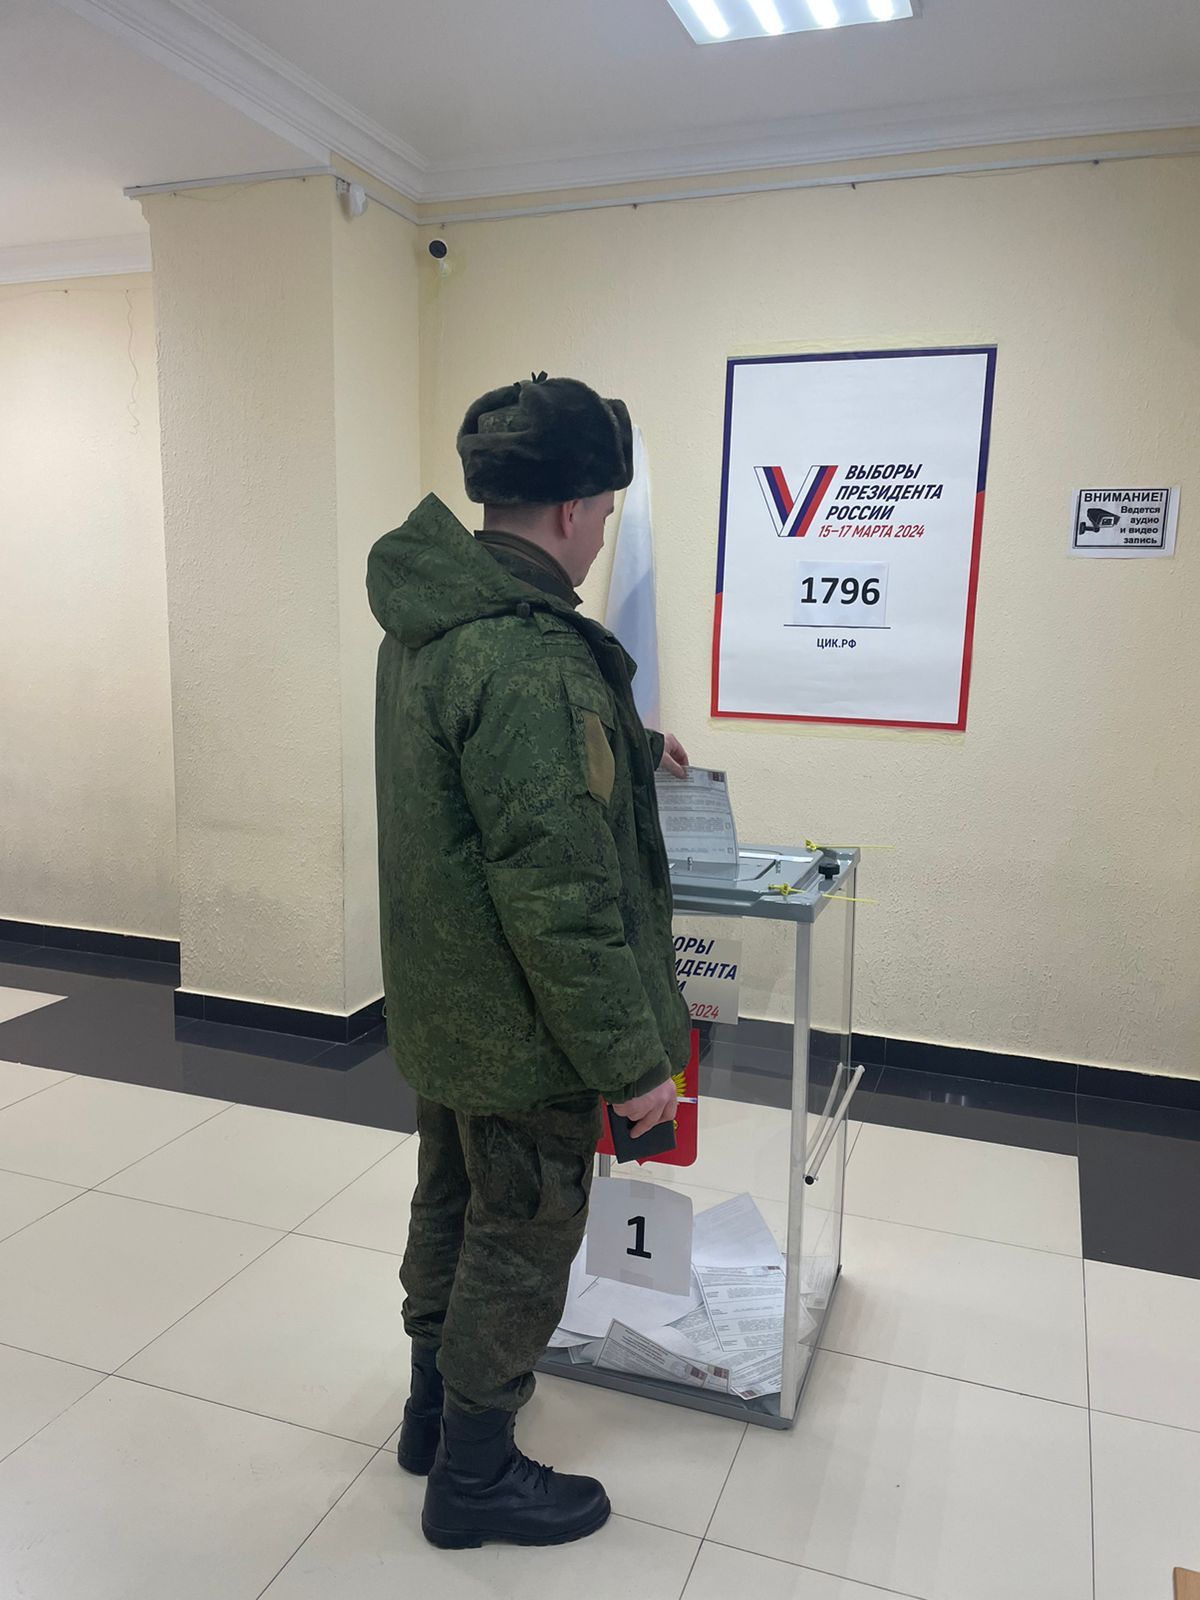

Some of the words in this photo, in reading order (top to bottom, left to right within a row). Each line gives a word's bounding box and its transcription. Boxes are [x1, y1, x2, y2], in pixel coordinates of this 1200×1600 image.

[845, 464, 923, 480] ВЫБОРЫ
[835, 484, 944, 502] ПРЕЗИДЕНТА
[1084, 492, 1163, 502] ВНИМАНИЕ!
[825, 505, 895, 520] РОССИИ
[1120, 506, 1160, 514] Ведется
[1130, 517, 1159, 525] аудио
[851, 525, 894, 538] МАРТА
[894, 525, 925, 538] 2024
[801, 577, 880, 605] 1796
[816, 638, 857, 650] ЦИК.РФ
[673, 936, 715, 955] ОРЫ
[689, 1003, 720, 1019] 2024
[626, 1215, 652, 1258] 1
